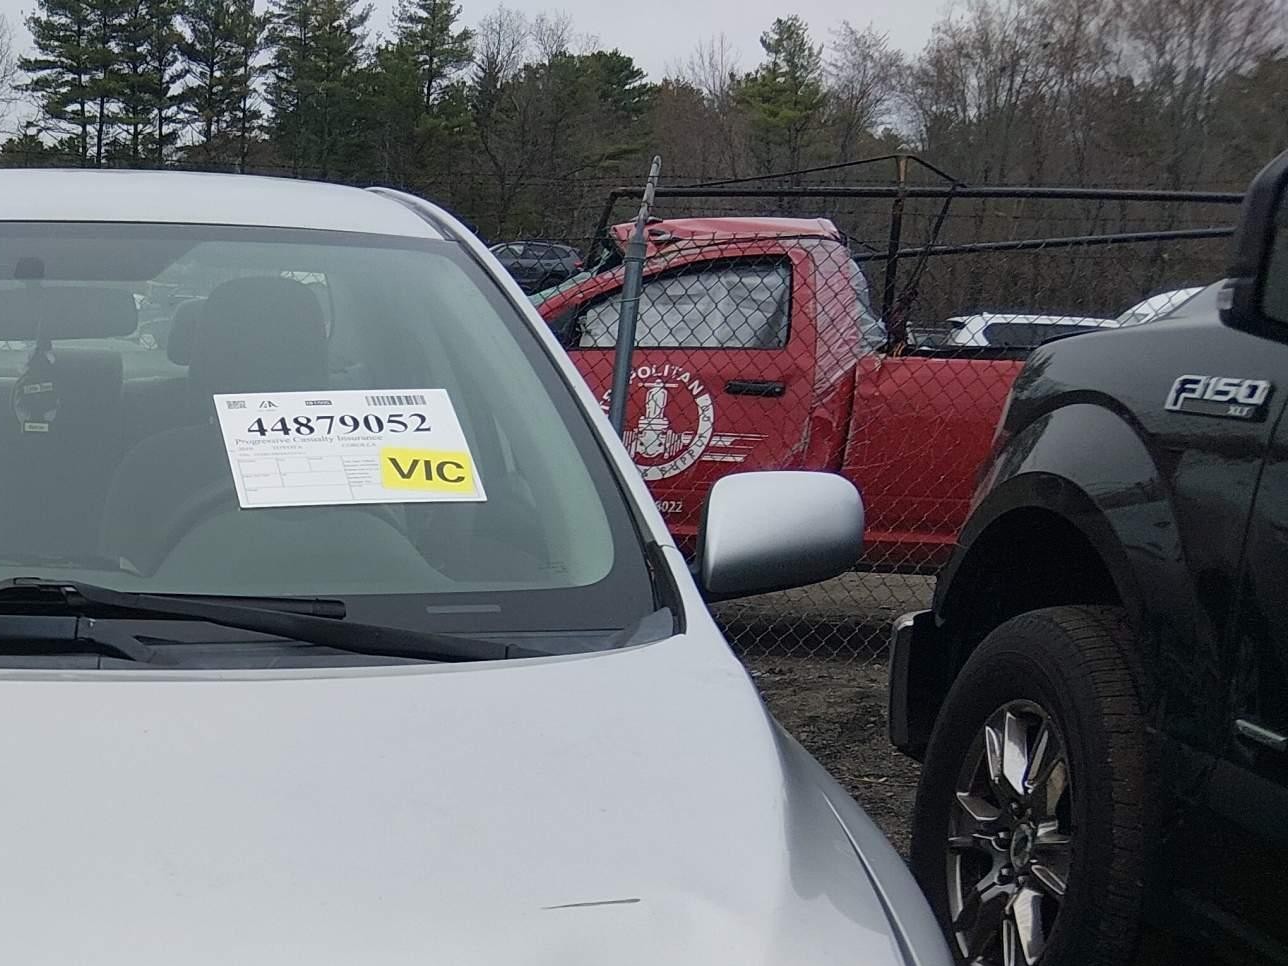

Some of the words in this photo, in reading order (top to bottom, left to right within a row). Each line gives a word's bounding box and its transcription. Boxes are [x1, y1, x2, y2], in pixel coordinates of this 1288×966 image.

[1227, 405, 1252, 416] XLT
[247, 413, 432, 437] 44879052
[388, 457, 465, 483] VIC
